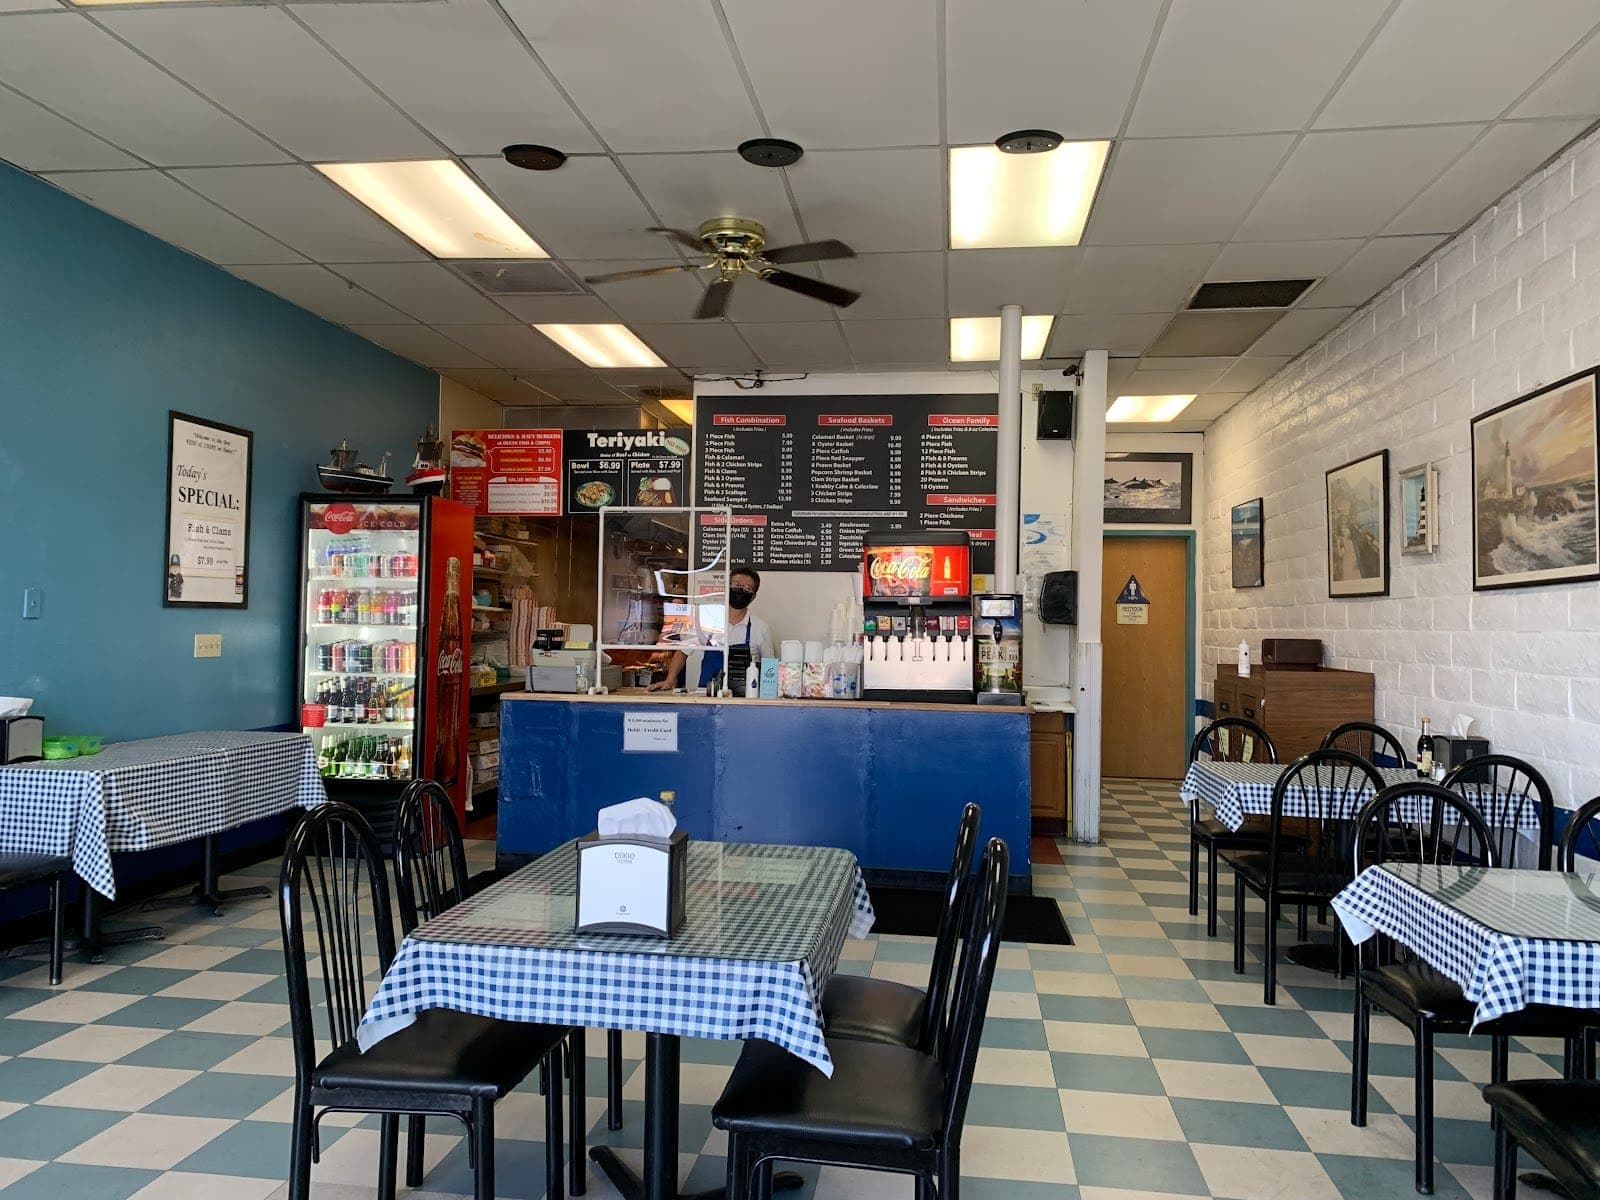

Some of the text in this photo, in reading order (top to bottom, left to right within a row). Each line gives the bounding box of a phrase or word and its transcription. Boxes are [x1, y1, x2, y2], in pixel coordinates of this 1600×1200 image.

[966, 417, 991, 425] Family
[587, 431, 665, 451] Teriyaki
[177, 465, 207, 483] Today's
[178, 486, 240, 511] SPECIAL:
[325, 511, 355, 522] Coca-Cola
[188, 524, 204, 533] Fish
[212, 526, 232, 536] Clams
[870, 556, 932, 579] Coca-Cola
[437, 648, 463, 676] Coca-Cola
